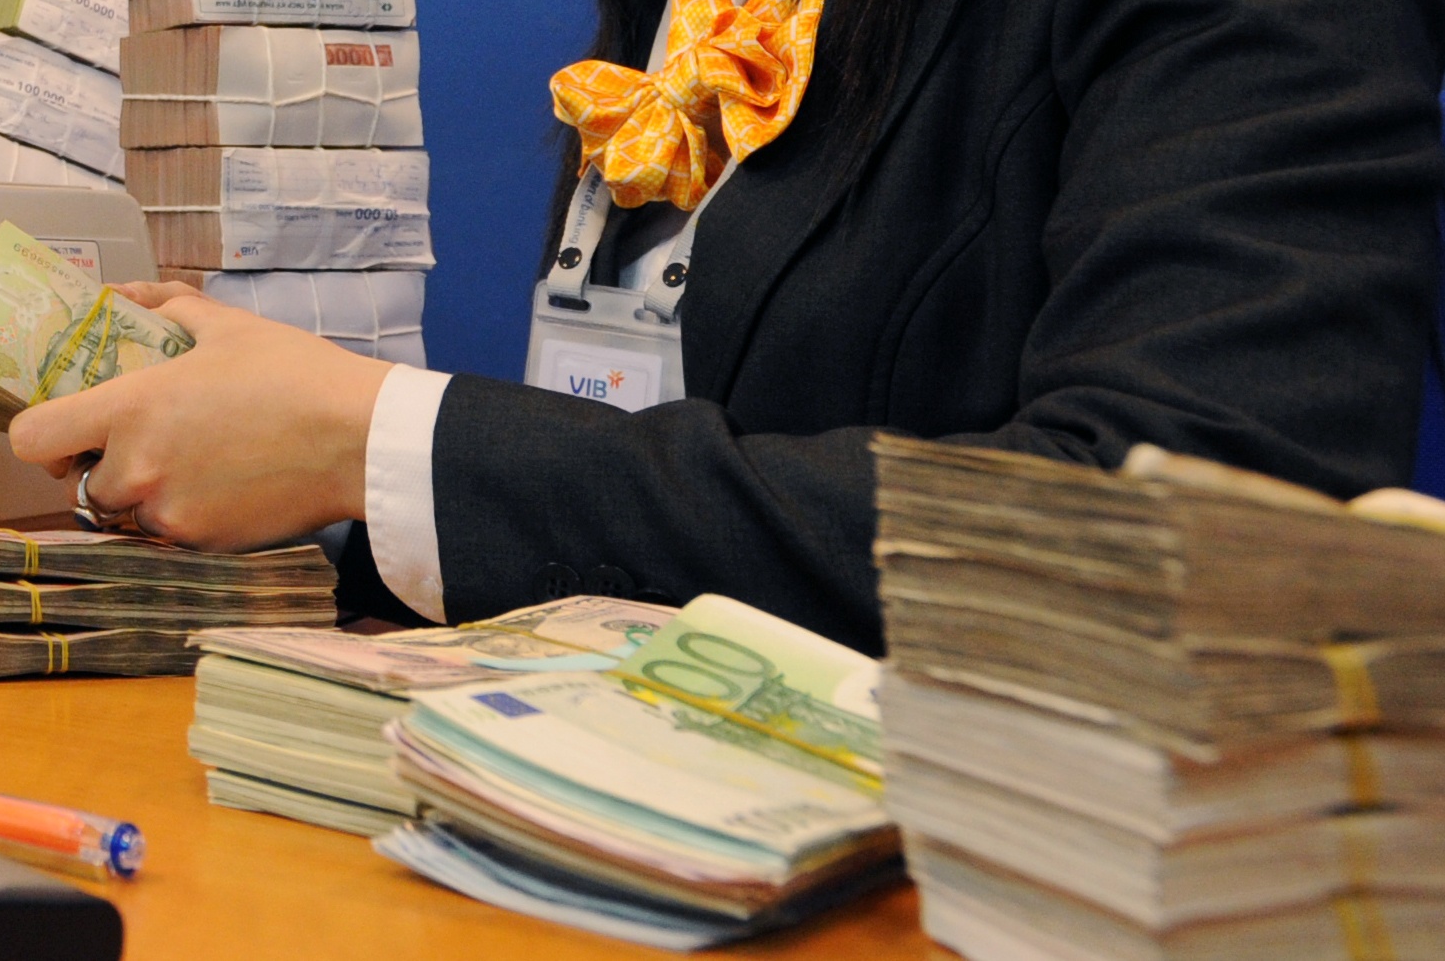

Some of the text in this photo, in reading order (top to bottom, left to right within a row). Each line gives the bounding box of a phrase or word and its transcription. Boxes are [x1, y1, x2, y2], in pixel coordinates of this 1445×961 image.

[567, 205, 590, 244] banking
[570, 374, 607, 399] VIB
[621, 632, 776, 706] 00
